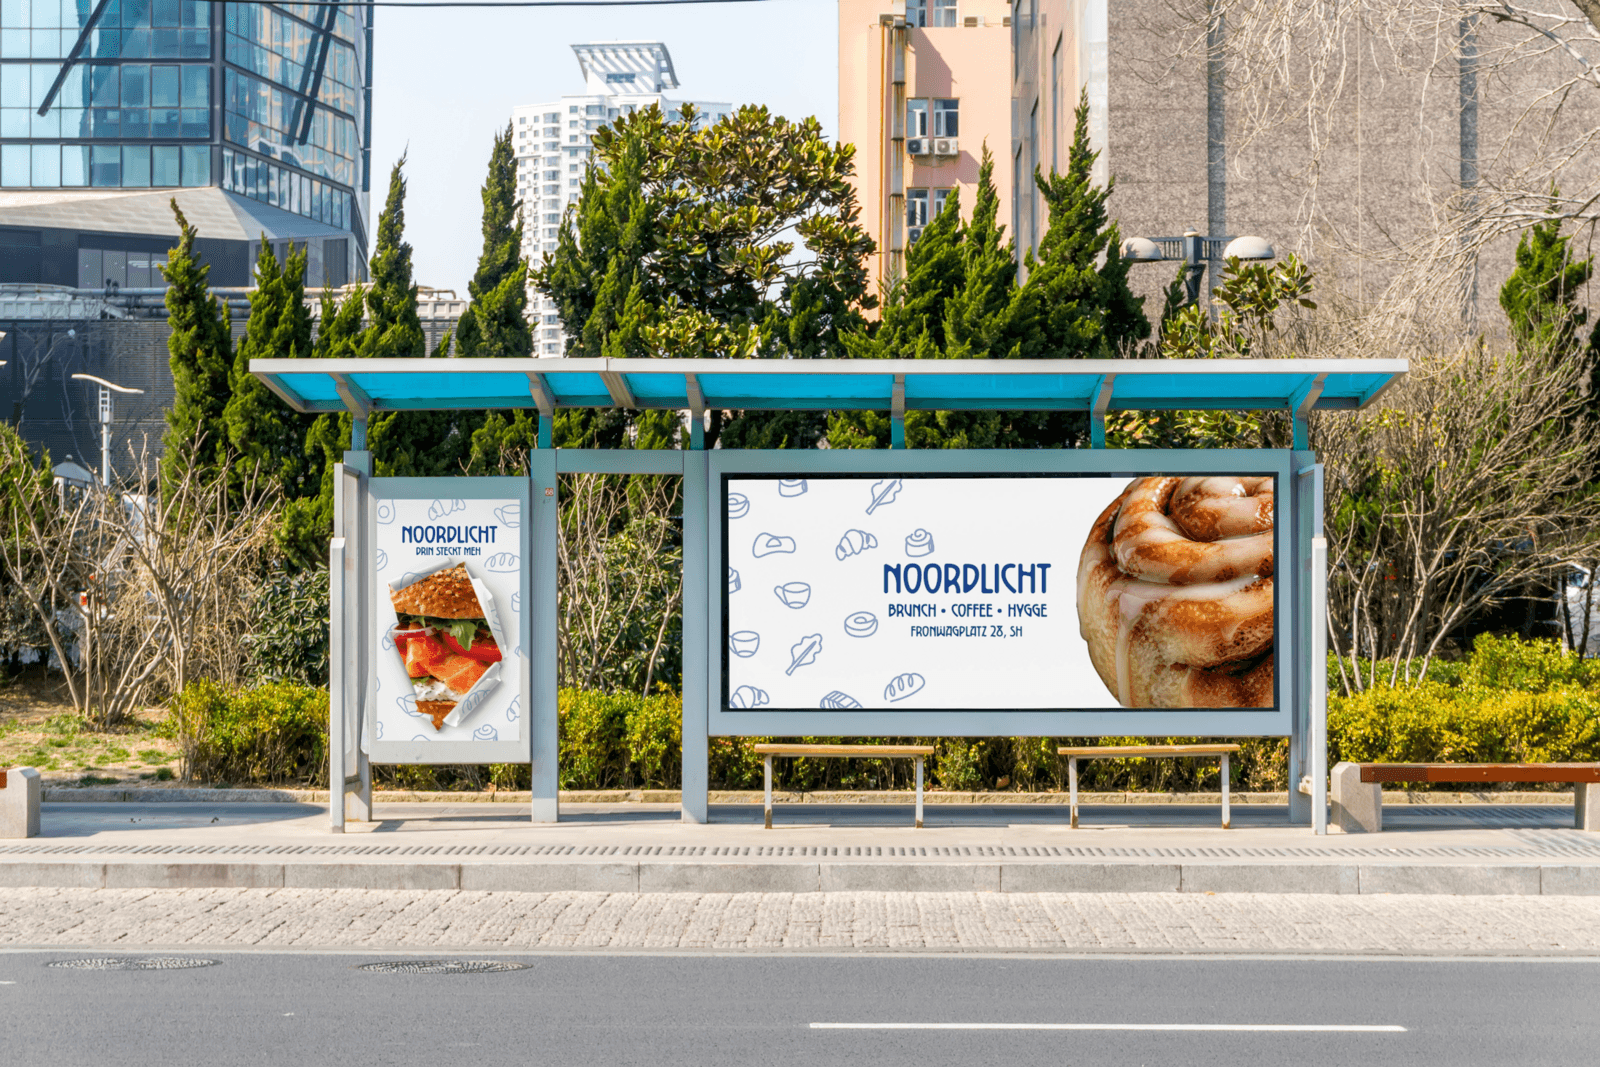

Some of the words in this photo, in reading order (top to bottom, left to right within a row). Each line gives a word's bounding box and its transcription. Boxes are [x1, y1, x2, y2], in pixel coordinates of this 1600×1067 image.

[402, 525, 498, 543] NOORDLICHT
[416, 546, 434, 556] DRIN
[436, 546, 462, 556] STECKT
[464, 546, 481, 556] MEH
[884, 563, 1051, 594] NOORDLICHT
[888, 603, 937, 618] BRUNCH
[951, 603, 993, 618] COFFEE
[1008, 603, 1048, 618] HYGGE
[910, 625, 987, 637] FRONWAGPLATZ
[990, 625, 1007, 639] 28,
[1010, 625, 1023, 637] SH
